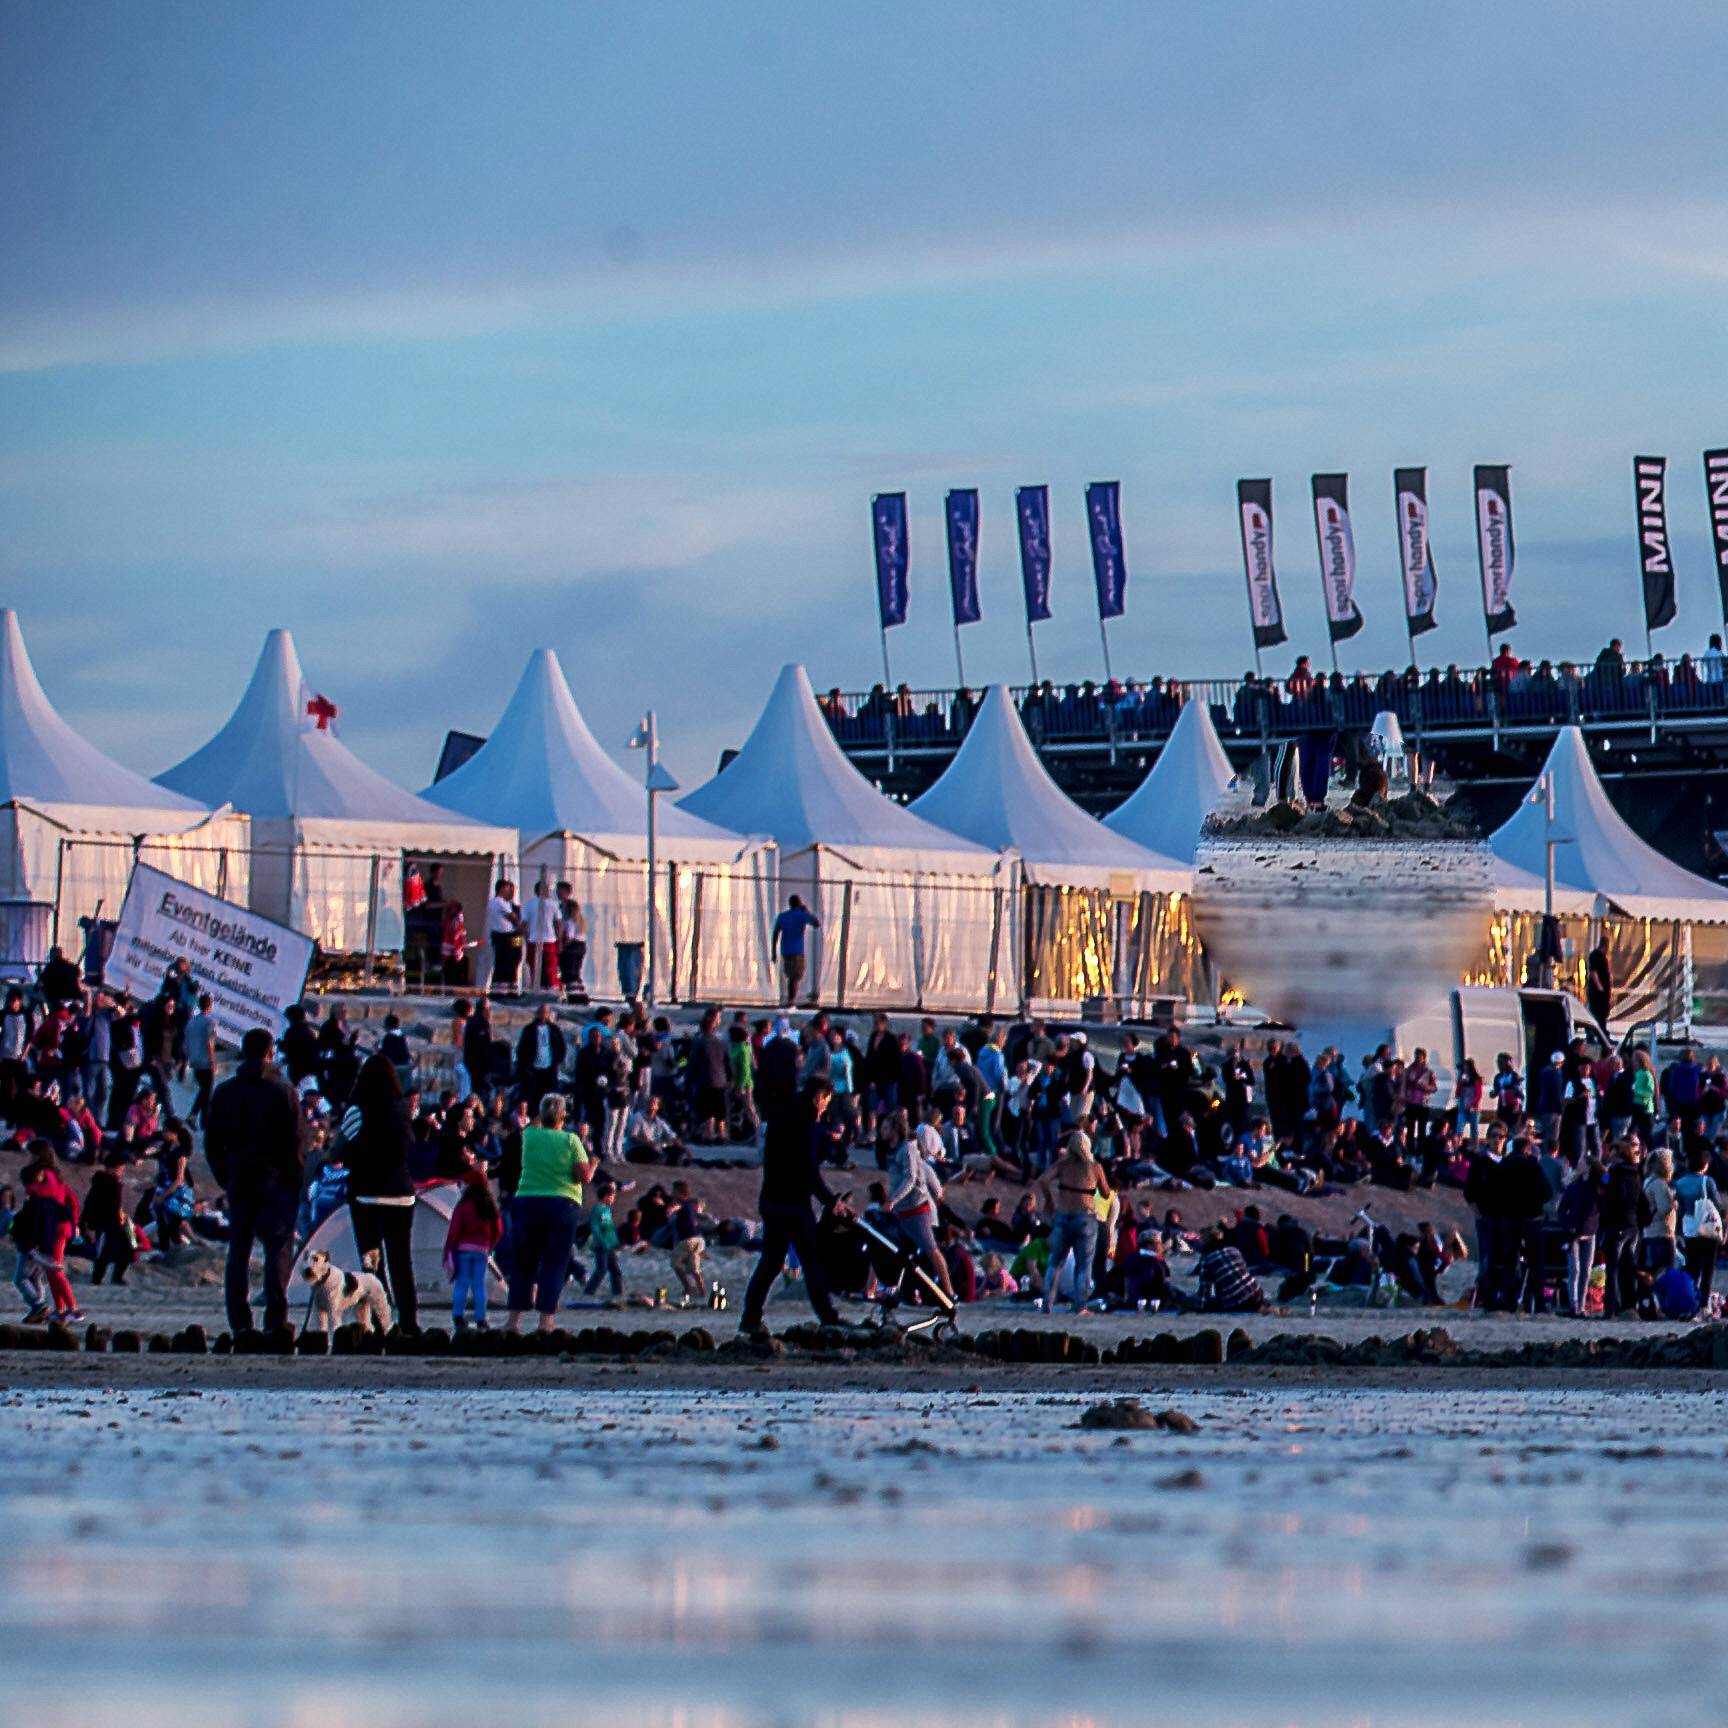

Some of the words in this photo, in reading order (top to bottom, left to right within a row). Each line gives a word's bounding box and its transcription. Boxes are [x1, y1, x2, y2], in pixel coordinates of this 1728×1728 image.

[1639, 463, 1669, 572] MINI
[161, 892, 278, 959] Eventgelände
[169, 929, 187, 946] Ab
[213, 949, 254, 976] KEINE
